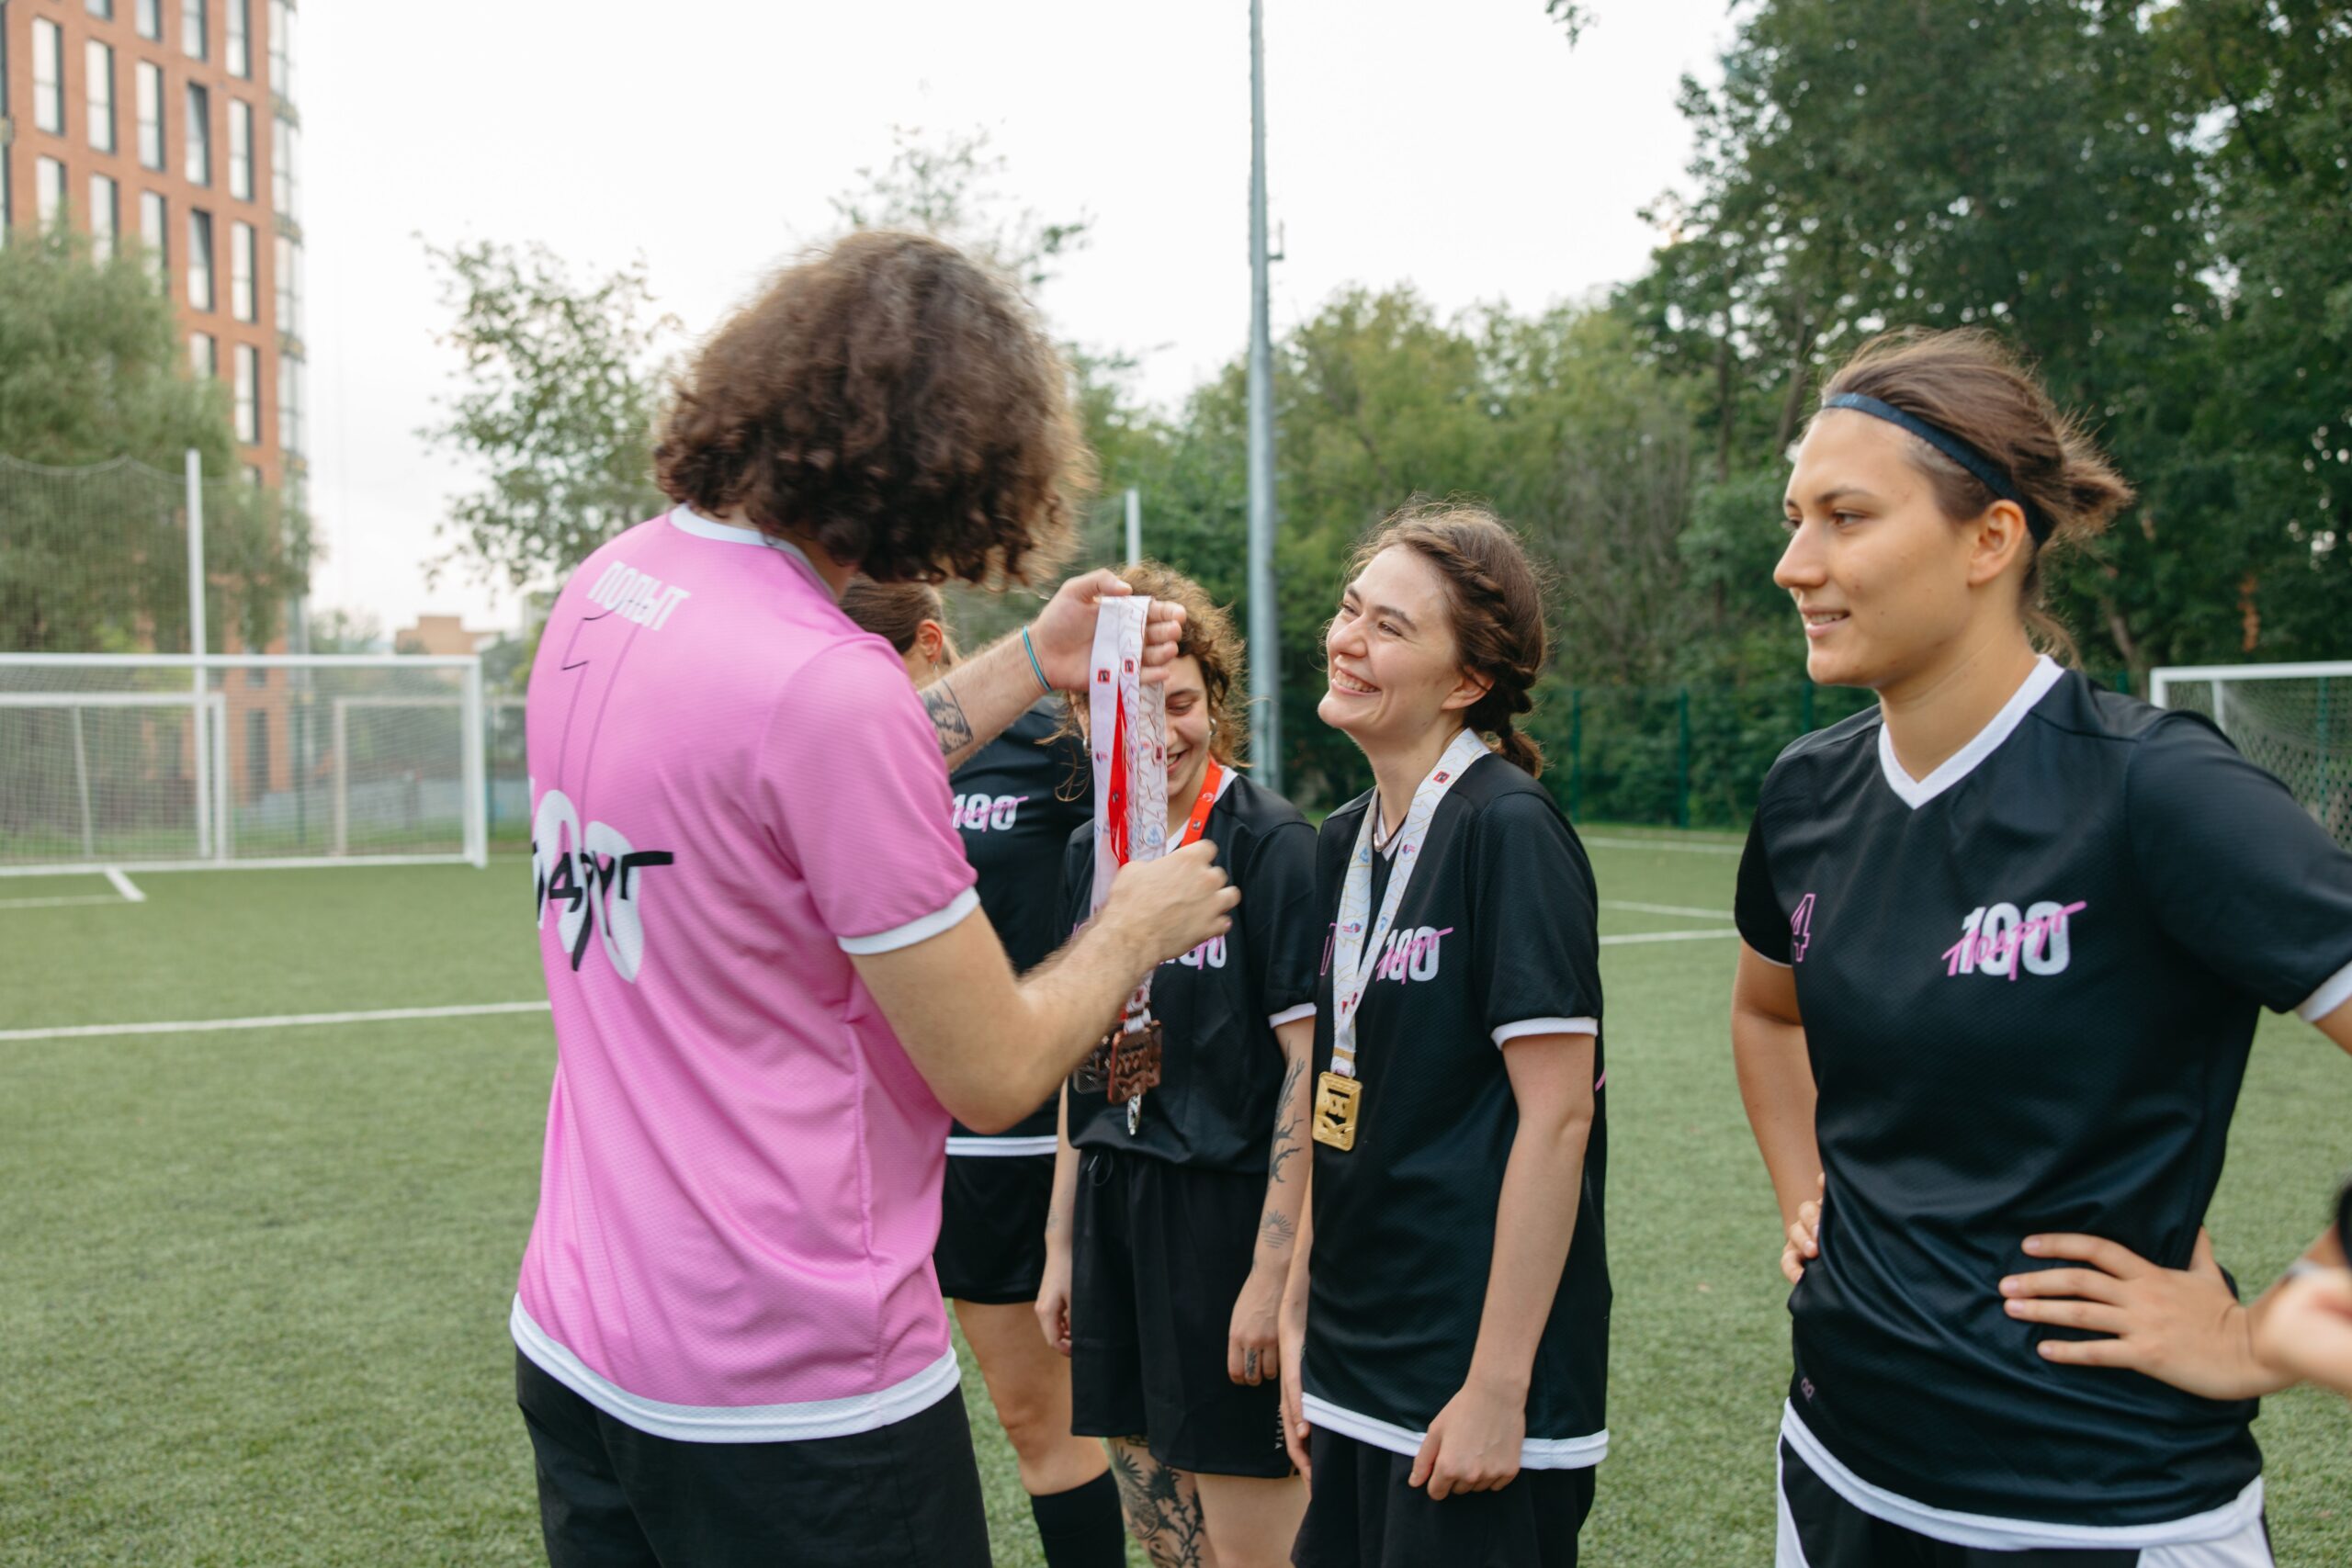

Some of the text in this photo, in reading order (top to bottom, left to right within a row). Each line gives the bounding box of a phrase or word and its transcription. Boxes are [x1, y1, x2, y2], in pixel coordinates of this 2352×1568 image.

[952, 793, 1019, 831] 100
[529, 777, 643, 985] 00
[1385, 925, 1441, 982] 100
[1961, 900, 2071, 976] 100
